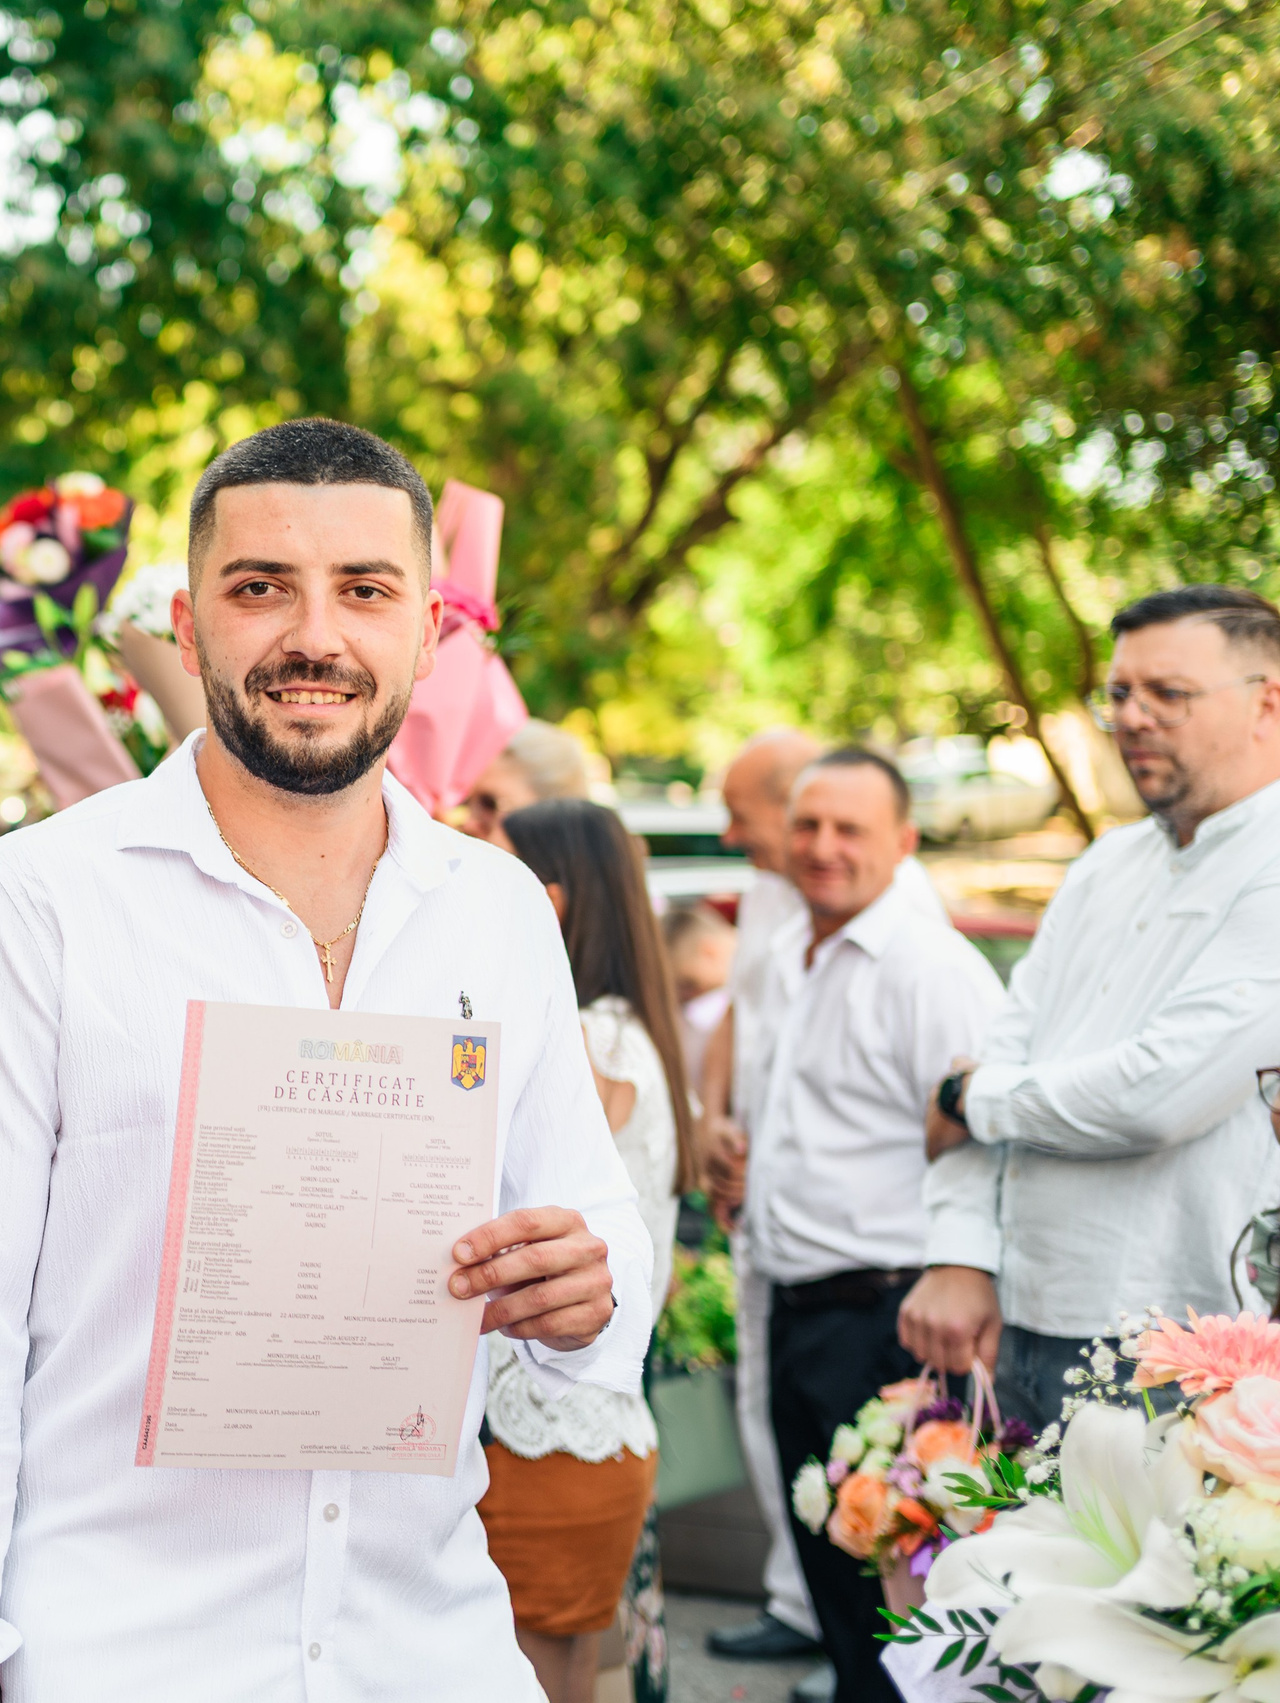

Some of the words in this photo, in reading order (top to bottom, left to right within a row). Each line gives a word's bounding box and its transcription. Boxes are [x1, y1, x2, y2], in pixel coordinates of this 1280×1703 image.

[300, 1039, 401, 1064] ROMÂNIA
[286, 1070, 415, 1090] CERTIFICAT
[274, 1086, 297, 1099] DE
[307, 1086, 424, 1107] CĂSĂTORIE
[271, 1105, 308, 1115] CERTIFICAT
[317, 1108, 346, 1117] MARIAGE
[351, 1111, 382, 1119] MARRIAGE
[383, 1113, 421, 1122] CERTIFICATE
